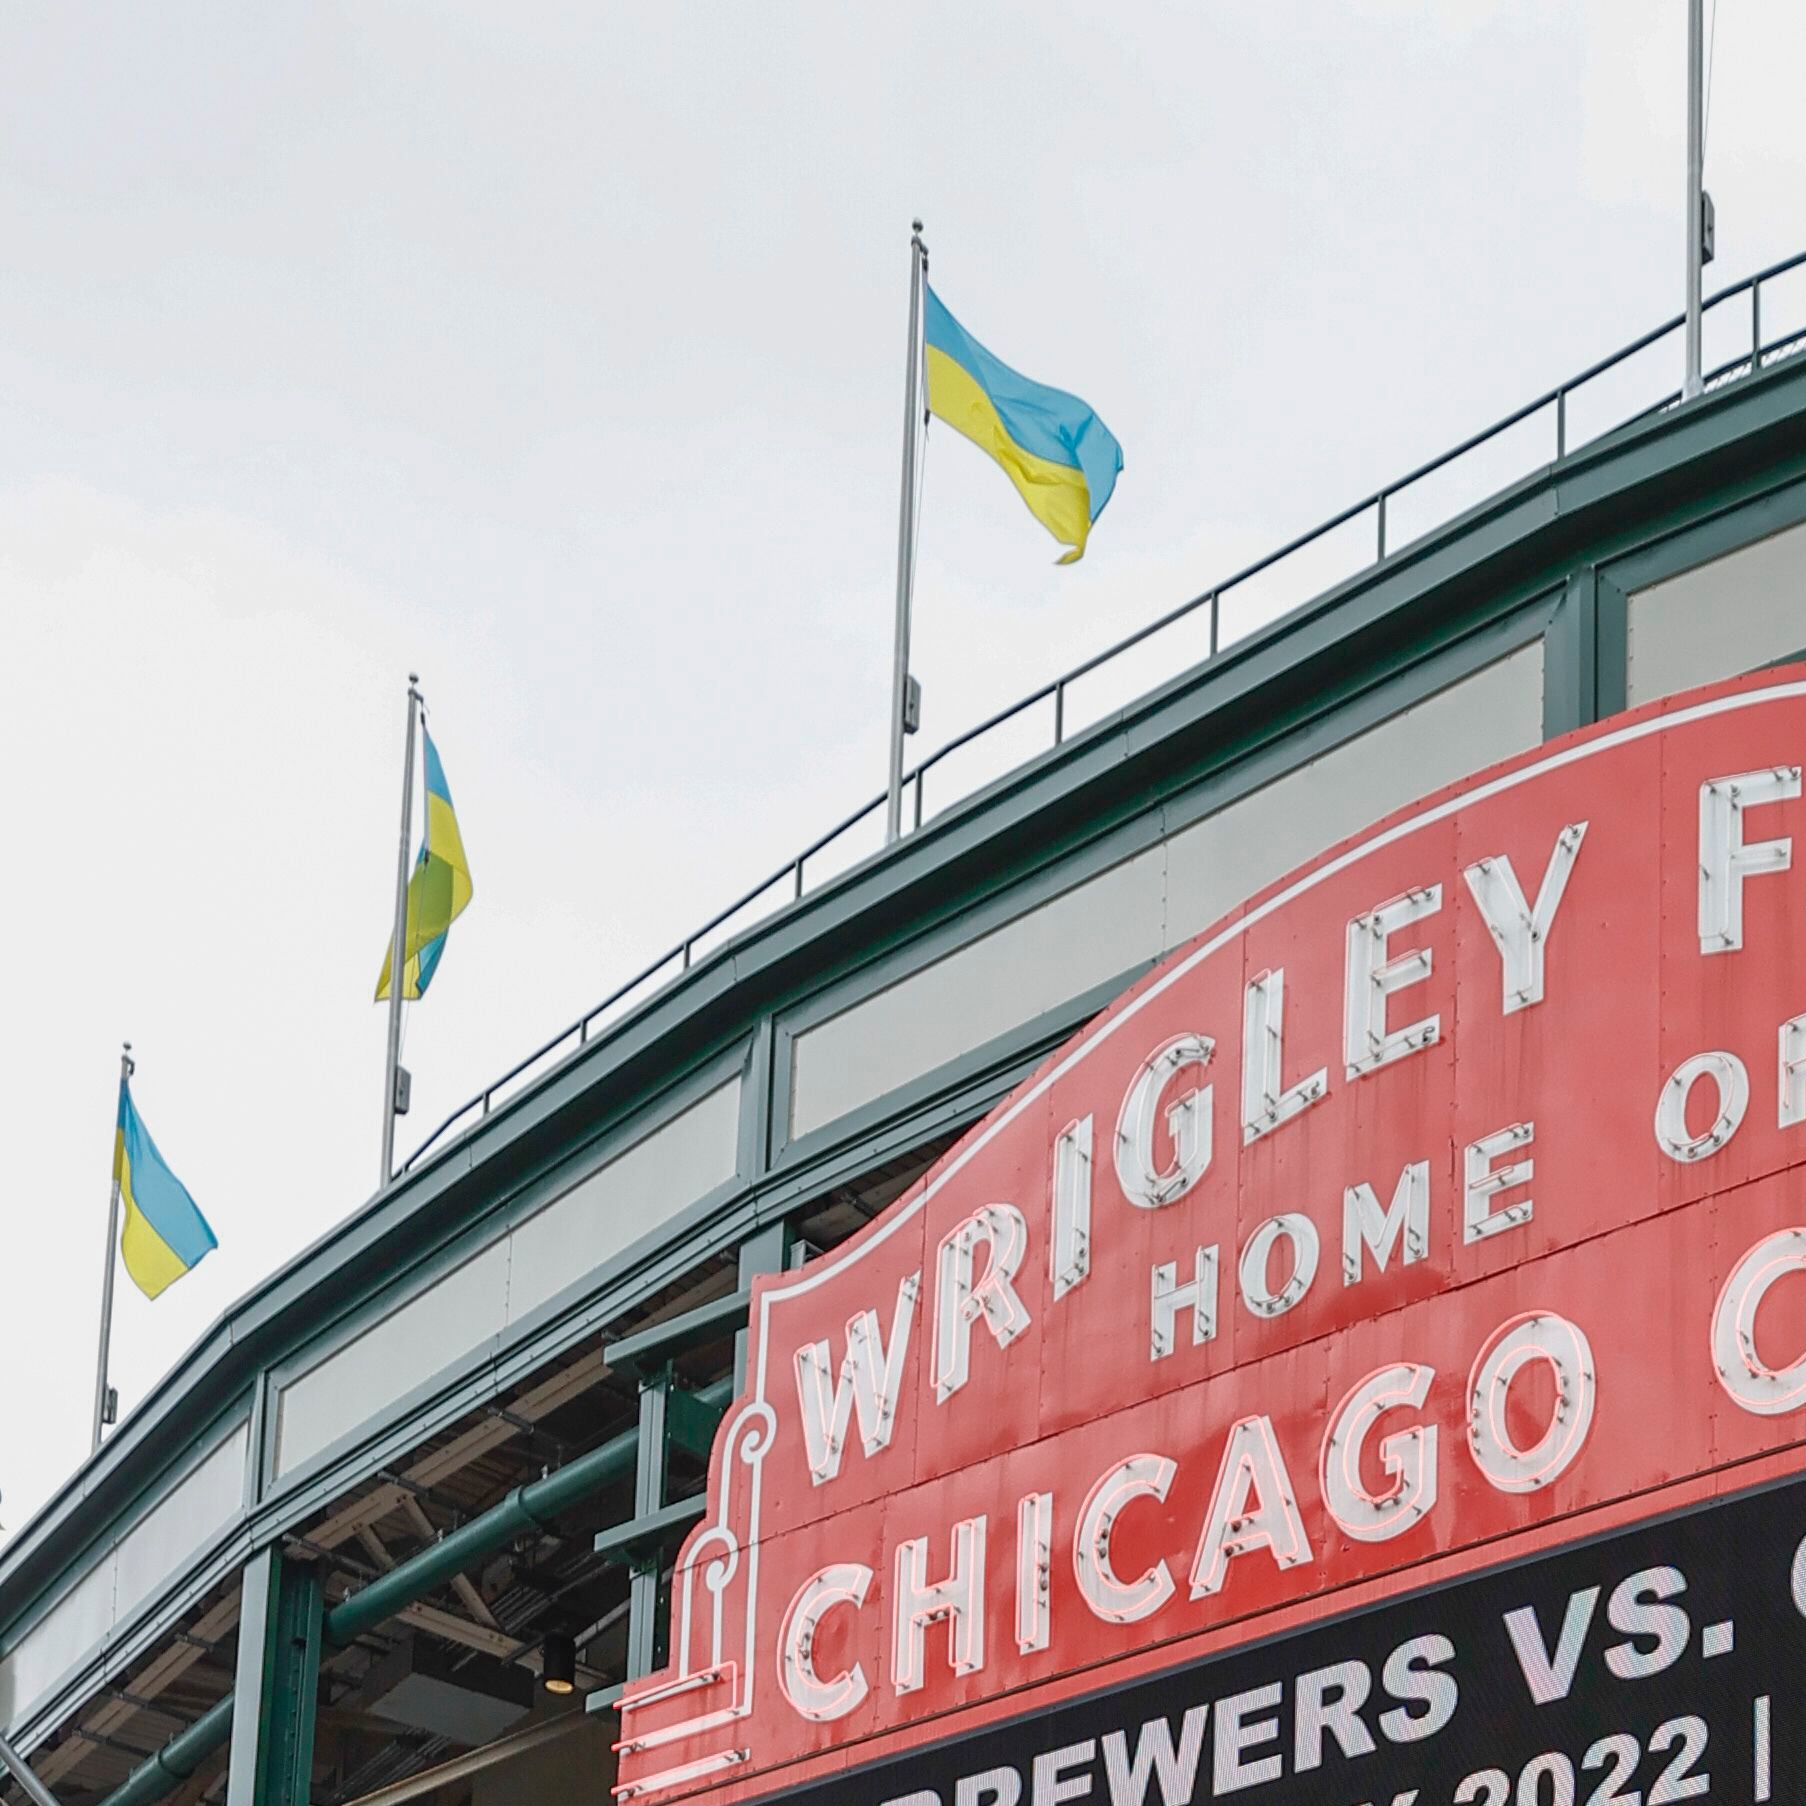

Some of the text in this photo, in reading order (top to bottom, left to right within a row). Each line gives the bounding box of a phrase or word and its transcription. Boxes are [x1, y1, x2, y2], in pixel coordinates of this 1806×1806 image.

[793, 820, 1590, 1482] WRIGLEY
[1150, 1122, 1535, 1363] HOME
[777, 1310, 1597, 1723] CHICAGO
[1502, 1566, 1735, 1706] VS.
